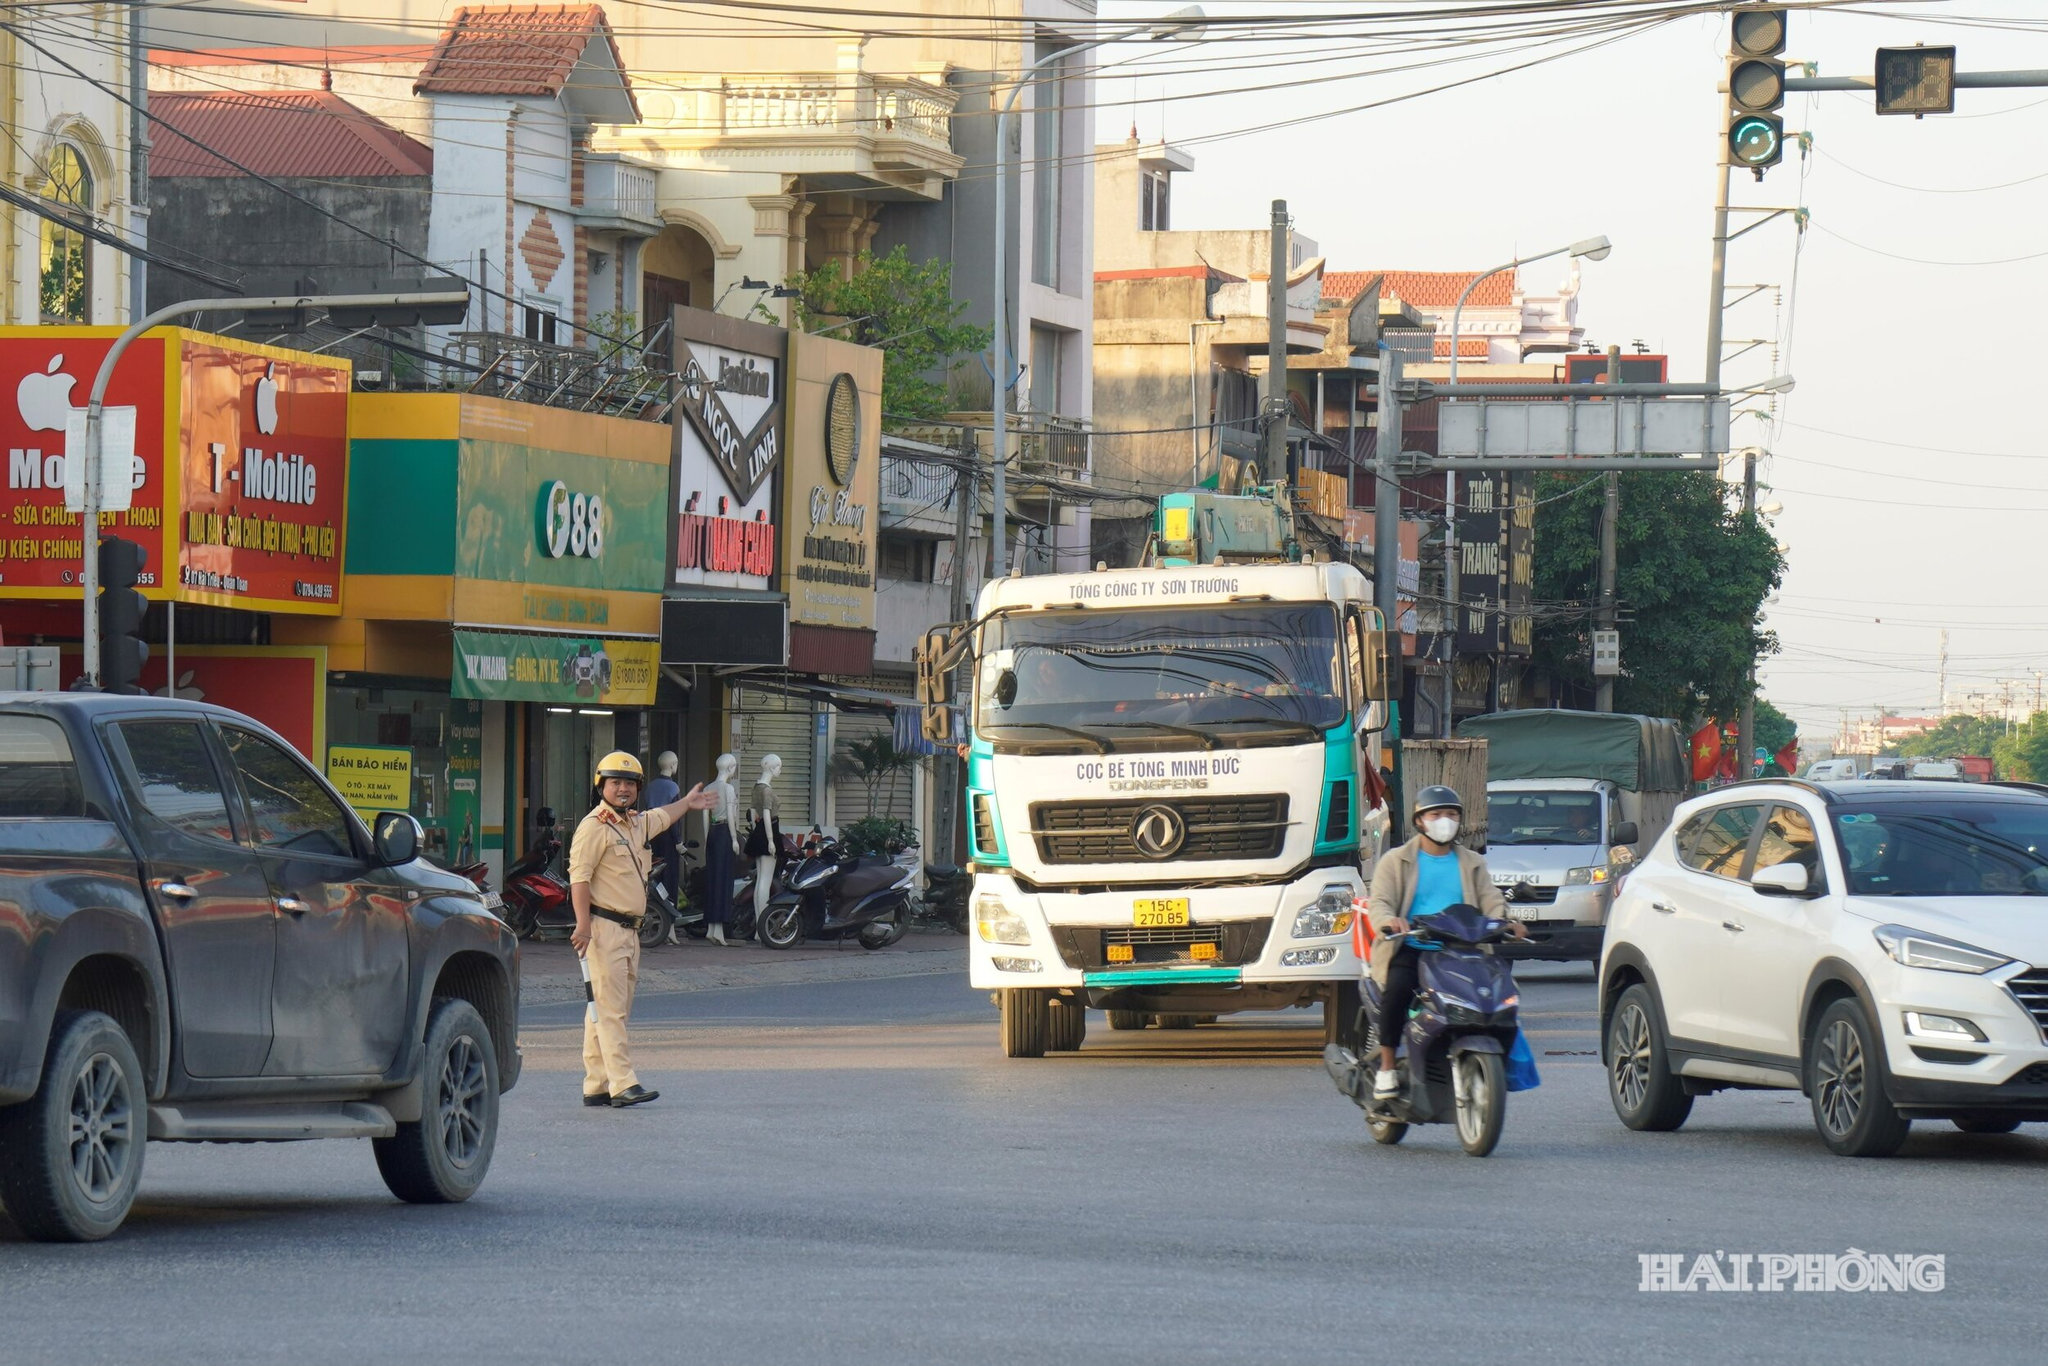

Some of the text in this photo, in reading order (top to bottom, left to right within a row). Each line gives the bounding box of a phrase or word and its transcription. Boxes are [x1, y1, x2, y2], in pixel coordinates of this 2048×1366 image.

[703, 390, 740, 470] NGỌC
[748, 426, 777, 485] LINH
[212, 442, 226, 493] T
[244, 447, 317, 505] Mobile
[1469, 471, 1494, 513] THỜI
[13, 499, 39, 526] SỬA
[124, 507, 160, 530] THOẠI
[10, 536, 39, 562] KIỆN
[42, 536, 83, 559] CHÍNH
[188, 511, 206, 543] MUA
[206, 507, 223, 545] BÁN
[227, 505, 242, 547] SỬA
[243, 513, 261, 550] CHỮA
[263, 513, 280, 557] ĐIỆN
[281, 521, 301, 560] THOẠI
[319, 520, 336, 562] KIỆN
[677, 491, 705, 569] MỐT
[705, 496, 744, 573] QUẢNG
[744, 509, 775, 577] CHÂU
[1461, 542, 1498, 576] TRANG
[1070, 579, 1101, 599] TỔNG
[1104, 580, 1137, 598] CÔNG
[1141, 581, 1155, 595] TY
[1161, 579, 1187, 595] SƠN
[1469, 593, 1487, 635] NỮ
[480, 655, 507, 681] NHANH
[515, 651, 537, 682] ĐĂNG
[550, 658, 560, 683] XE
[332, 756, 408, 771] BÁN BẢO HIỂM
[1077, 754, 1240, 783] CỌC BÊ TÔNG MINH ĐỨC
[1109, 778, 1208, 791] DONGFENG
[1492, 874, 1540, 884] UZUKI
[1140, 912, 1183, 925] 270.85
[1151, 900, 1173, 911] 15C
